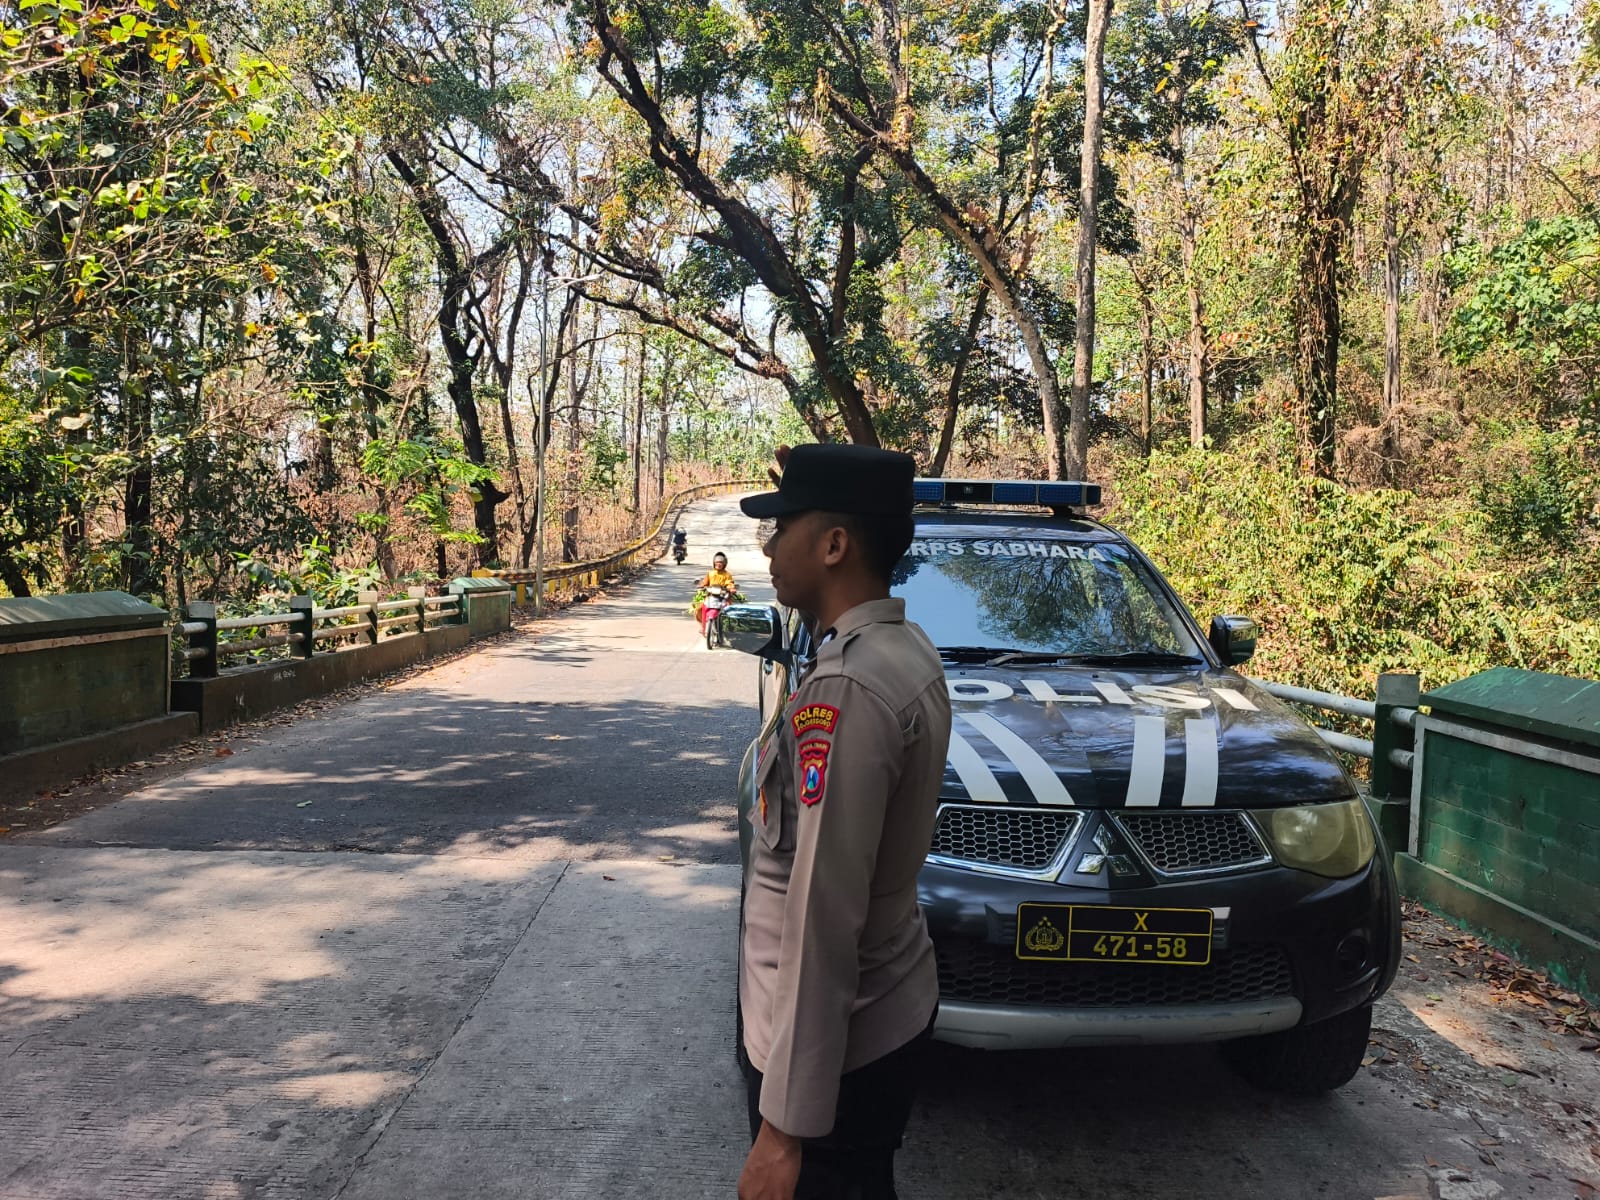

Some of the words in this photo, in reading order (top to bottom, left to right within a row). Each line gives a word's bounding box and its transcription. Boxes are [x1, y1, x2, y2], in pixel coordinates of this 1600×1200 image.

[903, 541, 966, 556] RPS
[973, 540, 1107, 562] SABHARA
[946, 679, 1261, 712] OLISI
[794, 707, 834, 731] POLRES
[1133, 912, 1149, 932] X
[1093, 935, 1187, 958] 471-58
